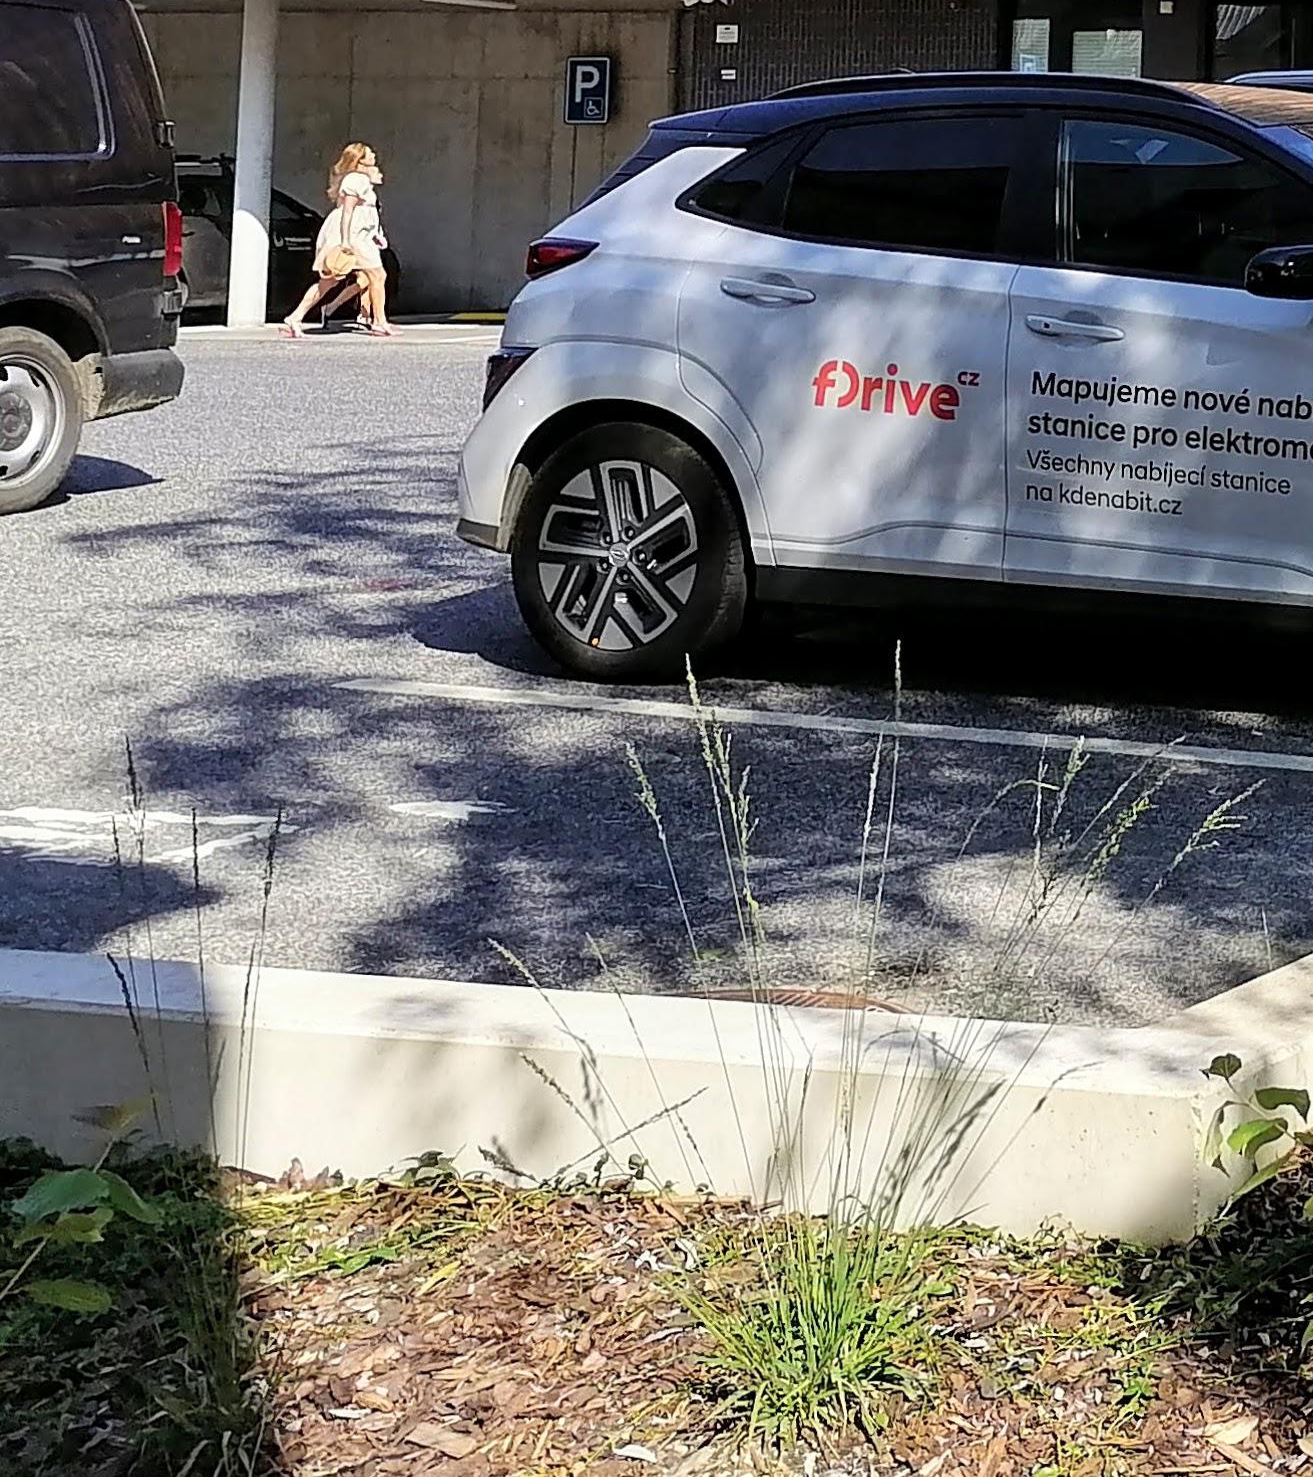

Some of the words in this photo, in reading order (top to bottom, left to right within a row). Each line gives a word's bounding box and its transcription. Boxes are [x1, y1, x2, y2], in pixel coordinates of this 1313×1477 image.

[575, 65, 600, 103] P
[812, 360, 960, 420] fDrive
[1031, 371, 1177, 407] Mapujeme
[1183, 388, 1250, 414] nové
[1027, 412, 1126, 442] stanice
[1132, 425, 1178, 449] pro
[1026, 449, 1116, 481] Všechny
[1121, 460, 1206, 487] nabíjecí
[1211, 470, 1291, 494] stanice
[1026, 484, 1053, 502] na
[1059, 482, 1183, 515] kdenabit.cz
